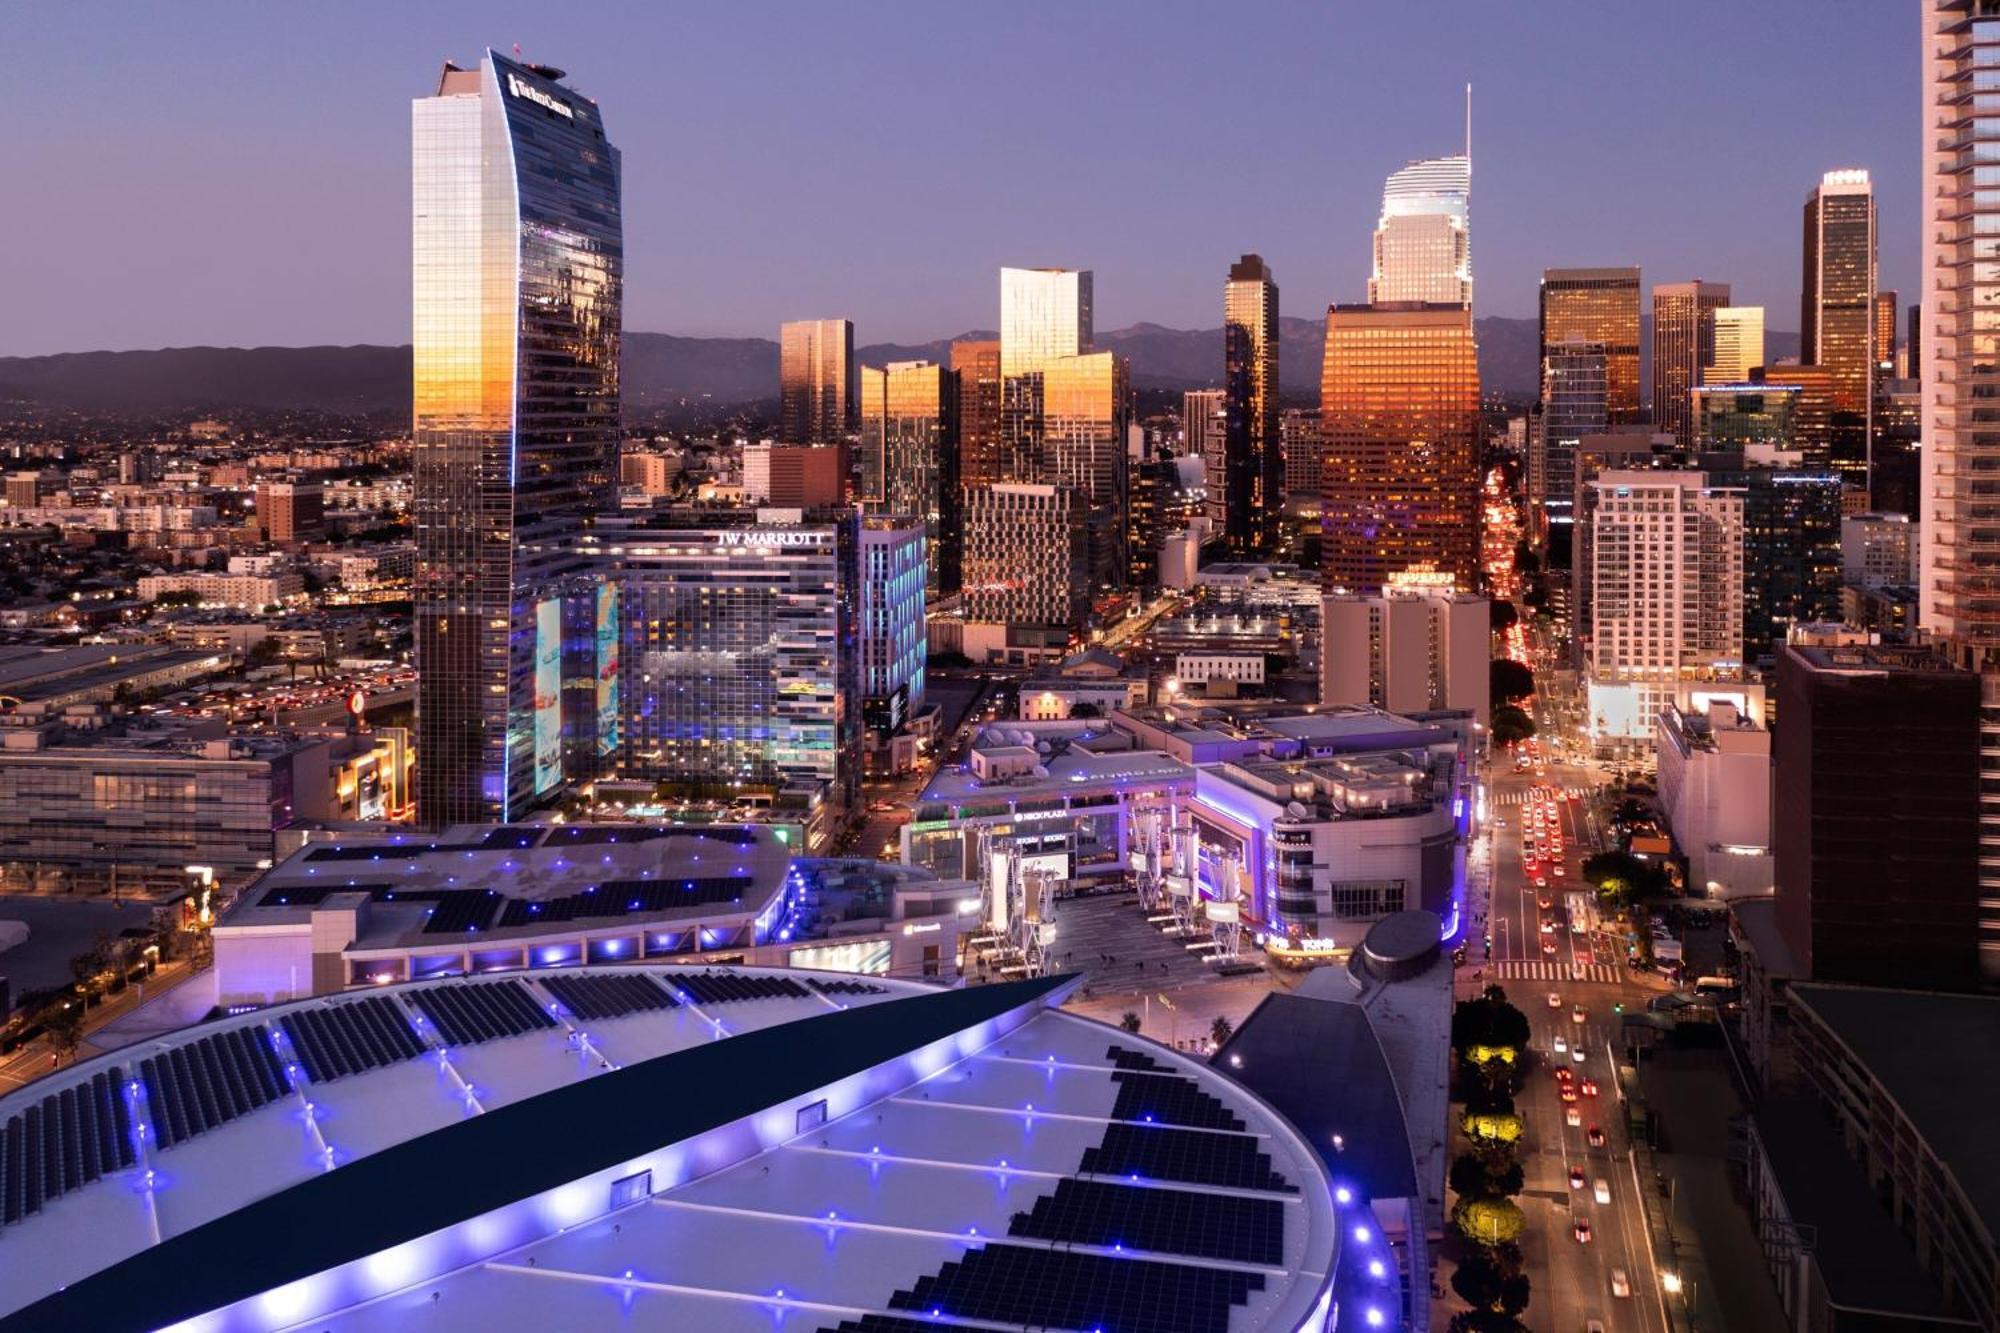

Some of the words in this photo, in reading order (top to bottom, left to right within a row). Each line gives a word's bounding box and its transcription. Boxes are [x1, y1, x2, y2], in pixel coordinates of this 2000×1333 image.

[719, 532, 741, 545] JW
[743, 532, 825, 545] MARRIOTT
[1043, 809, 1068, 819] PLAZA
